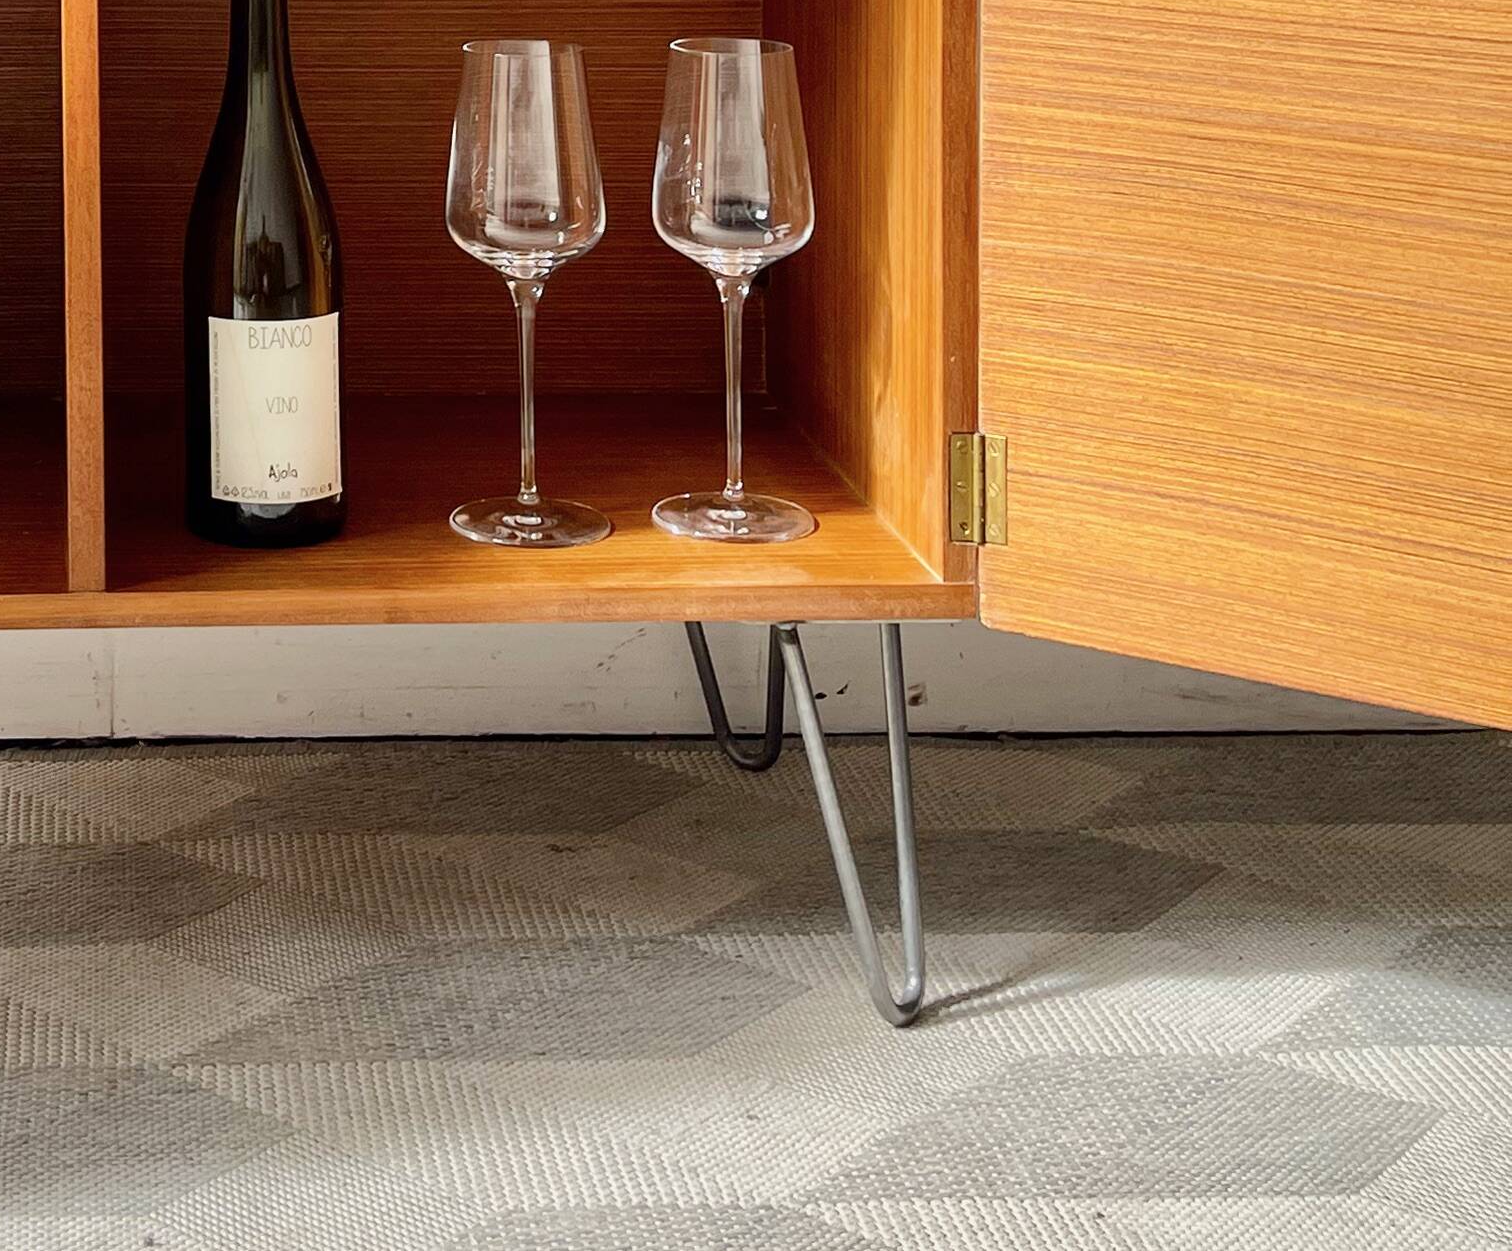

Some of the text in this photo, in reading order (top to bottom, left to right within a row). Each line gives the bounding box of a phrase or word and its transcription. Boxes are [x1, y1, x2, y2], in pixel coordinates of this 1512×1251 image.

[248, 324, 312, 350] BIANCO
[265, 396, 299, 414] VINO
[268, 462, 298, 483] Ajola
